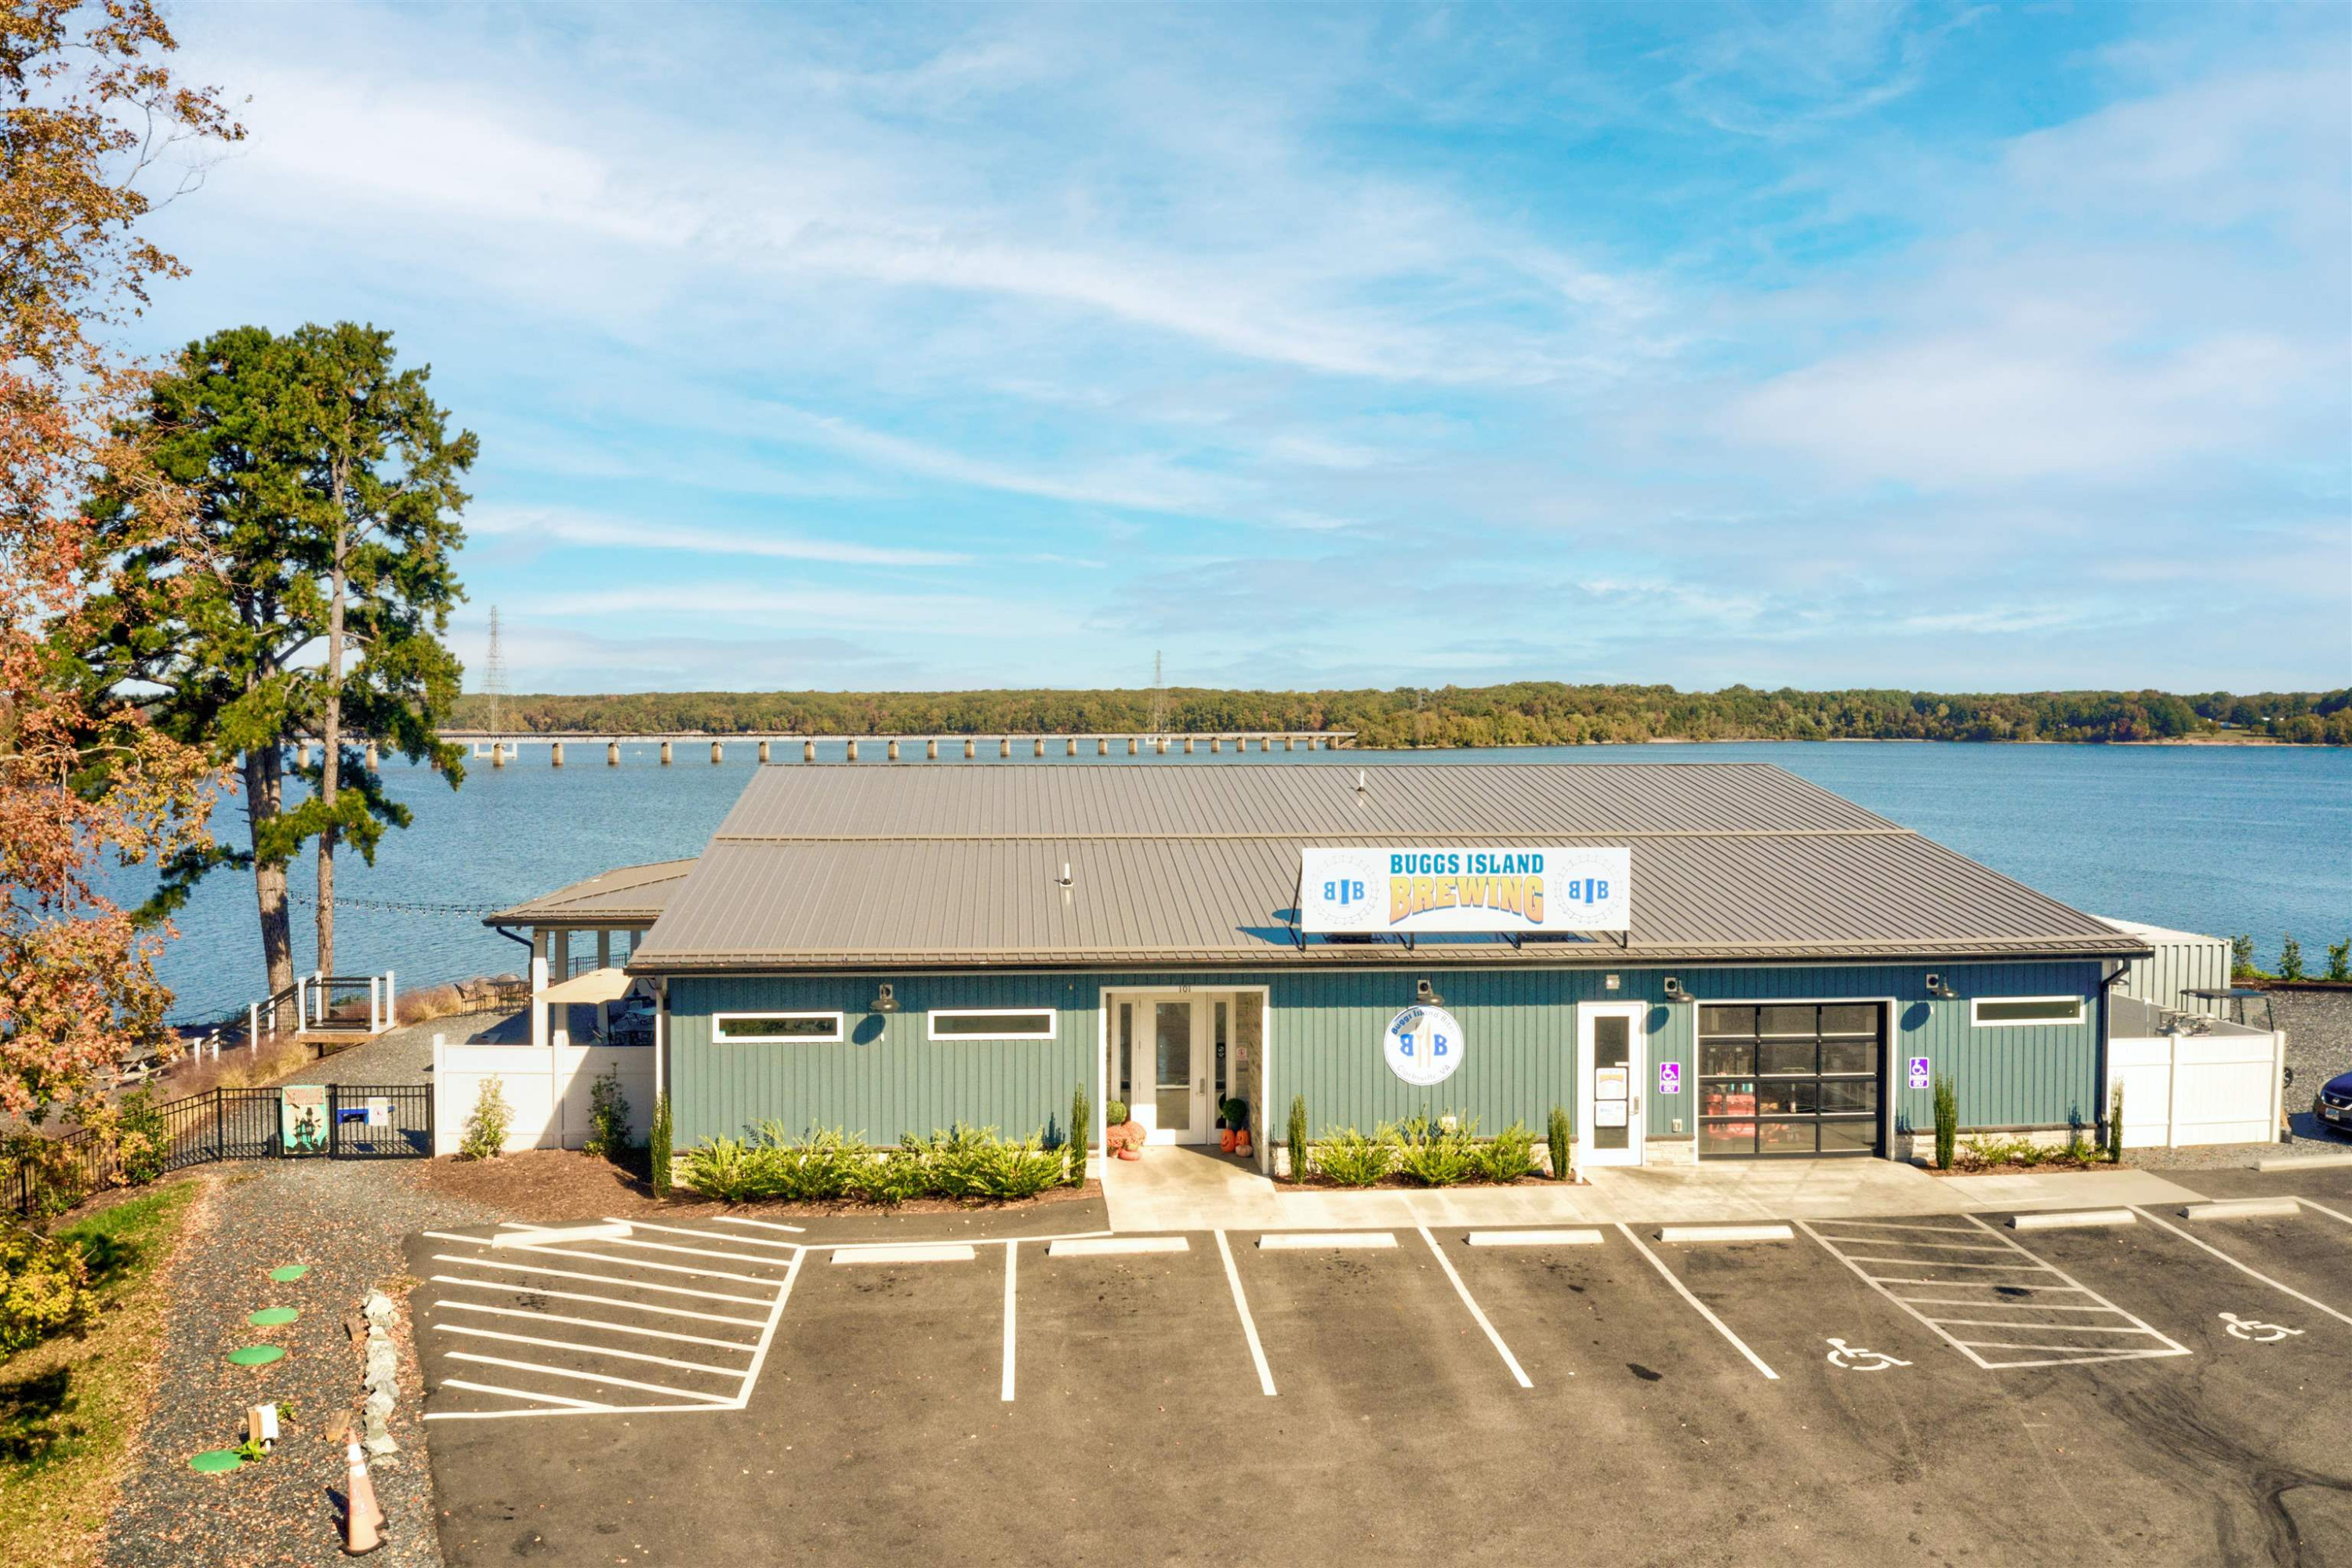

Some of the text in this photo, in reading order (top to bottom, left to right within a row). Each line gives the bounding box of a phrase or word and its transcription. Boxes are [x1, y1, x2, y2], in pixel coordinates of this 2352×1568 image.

[1390, 854, 1544, 874] BUGGS ISLAND
[1390, 876, 1544, 925] BREWING
[1179, 985, 1191, 993] 101
[1391, 1013, 1413, 1035] Buggs
